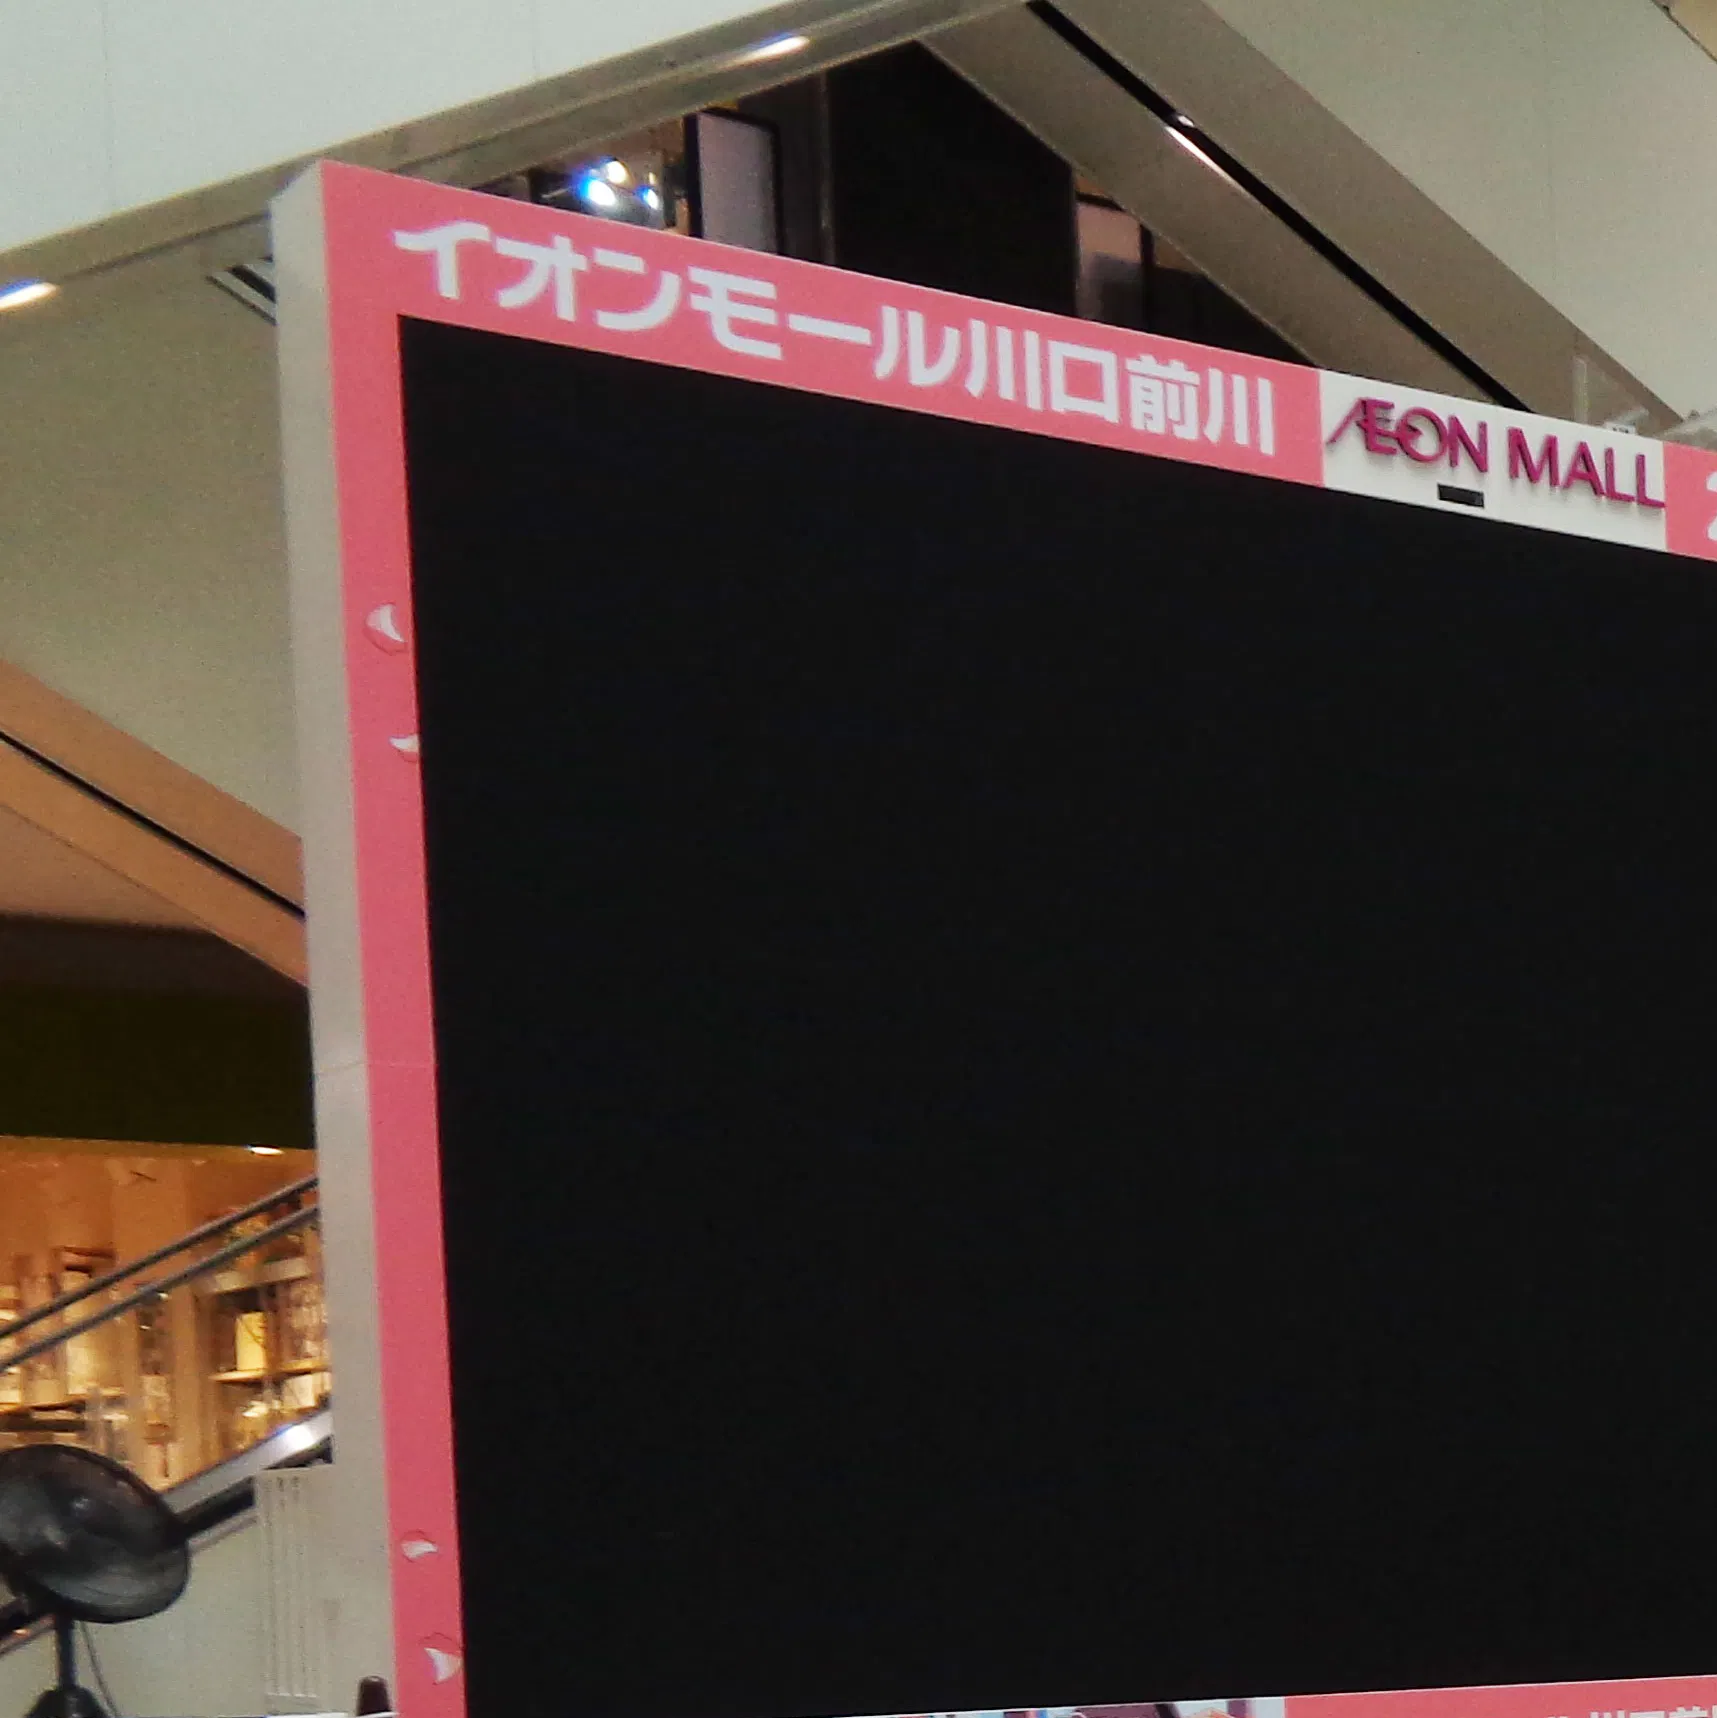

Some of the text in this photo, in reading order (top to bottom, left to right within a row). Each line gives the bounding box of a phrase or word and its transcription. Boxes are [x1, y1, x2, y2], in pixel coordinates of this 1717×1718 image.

[394, 220, 1275, 456] イオンモール川口前川
[1508, 426, 1666, 510] MALL
